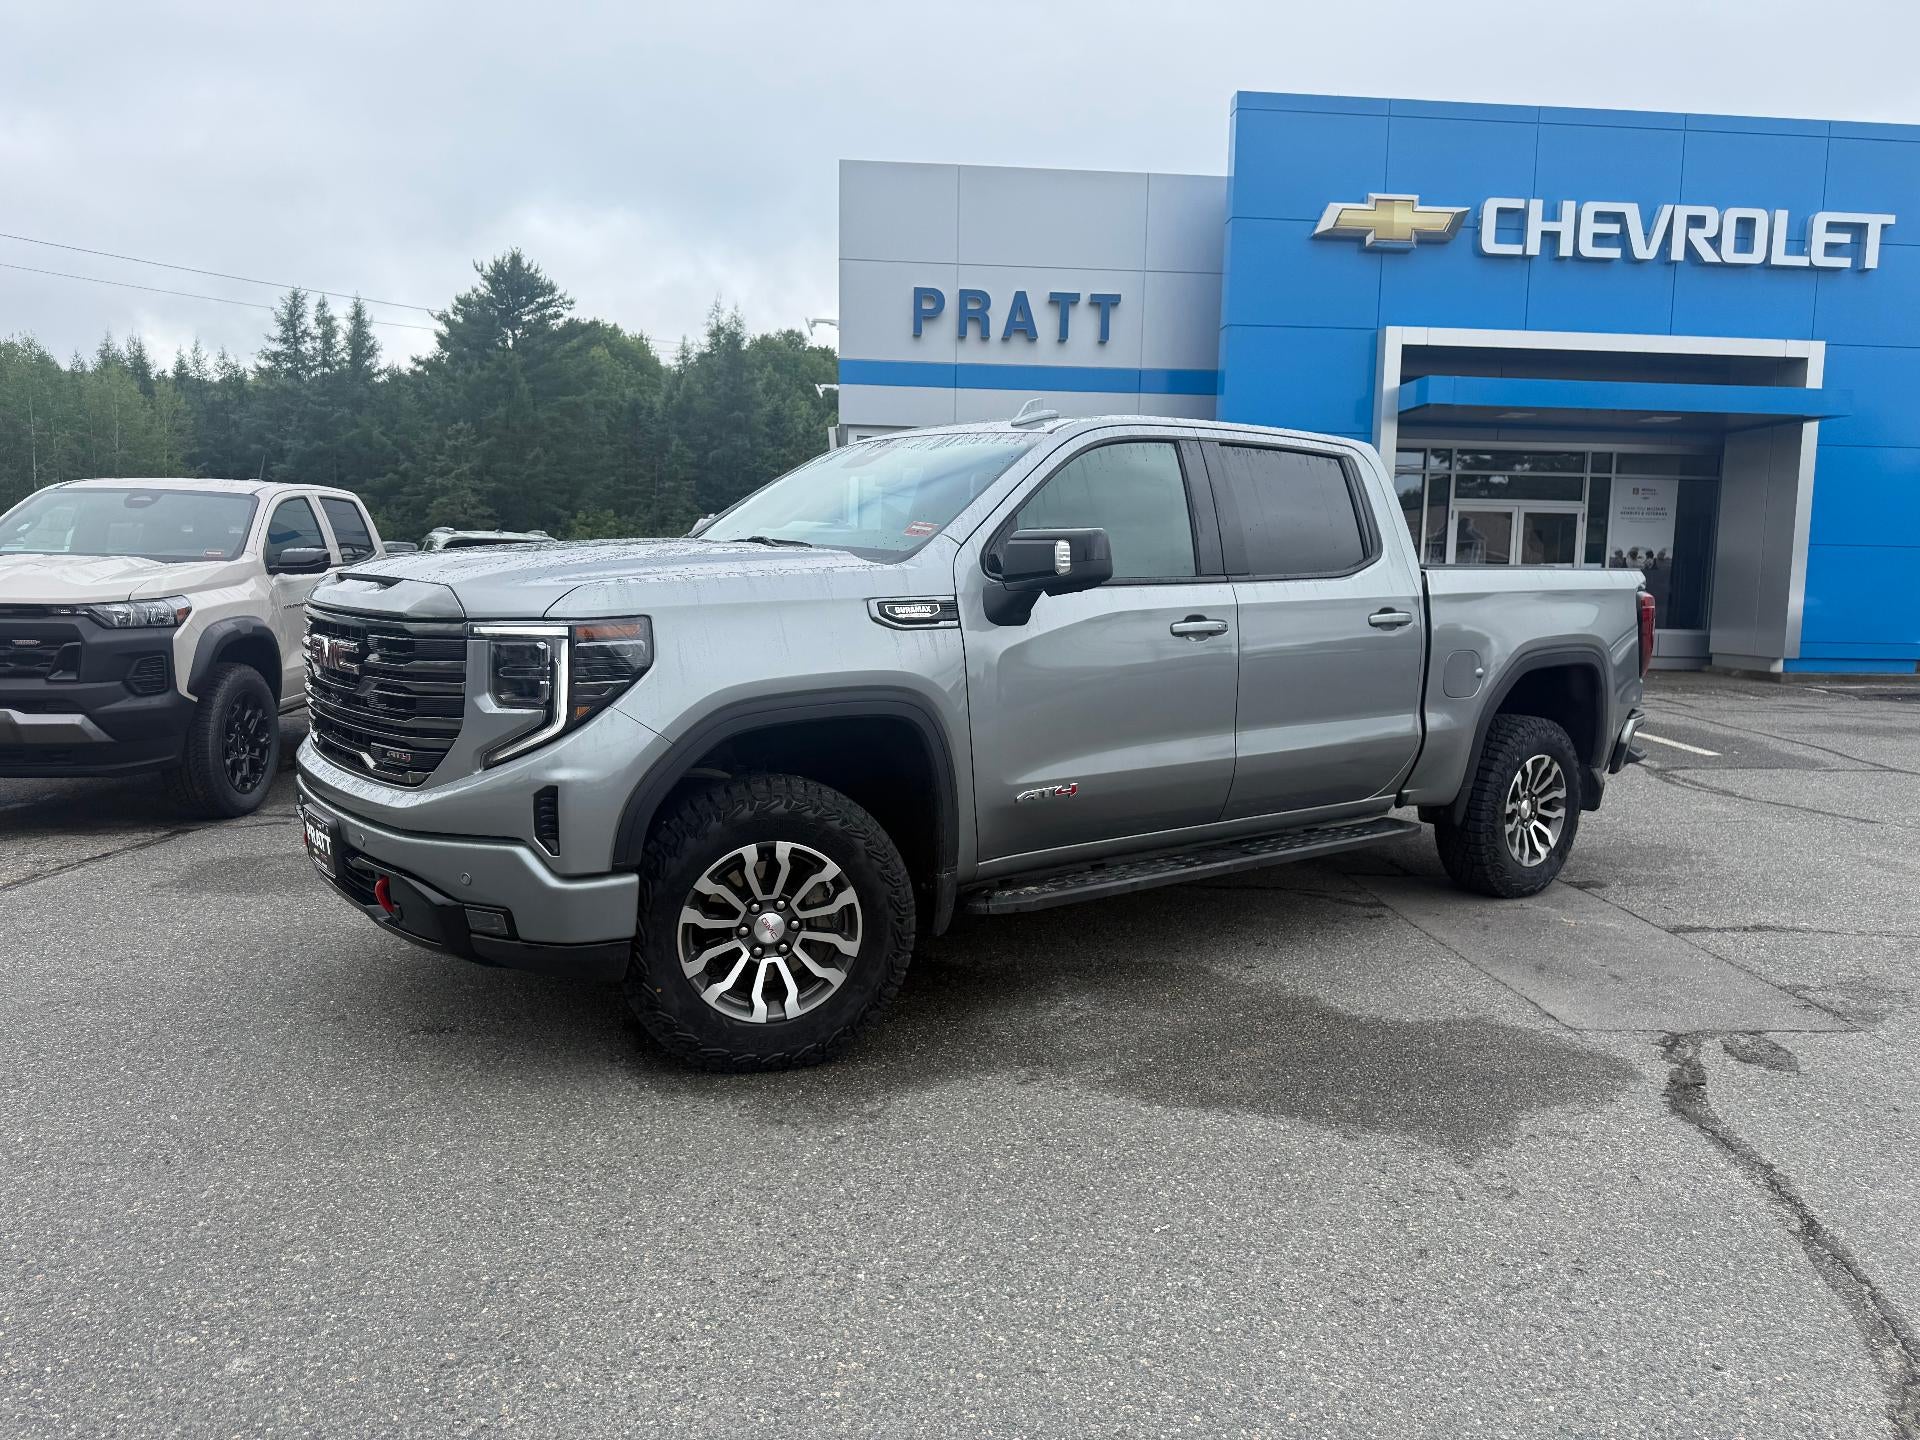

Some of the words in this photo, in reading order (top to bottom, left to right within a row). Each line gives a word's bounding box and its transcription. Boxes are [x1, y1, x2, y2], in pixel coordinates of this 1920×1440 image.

[1480, 197, 1897, 270] CHEVROLET
[912, 286, 1122, 343] PRATT
[894, 605, 932, 614] DURAMAX
[310, 633, 360, 676] GMC
[1015, 782, 1079, 802] AT4
[305, 820, 331, 856] PRATT
[761, 917, 779, 941] GMC
